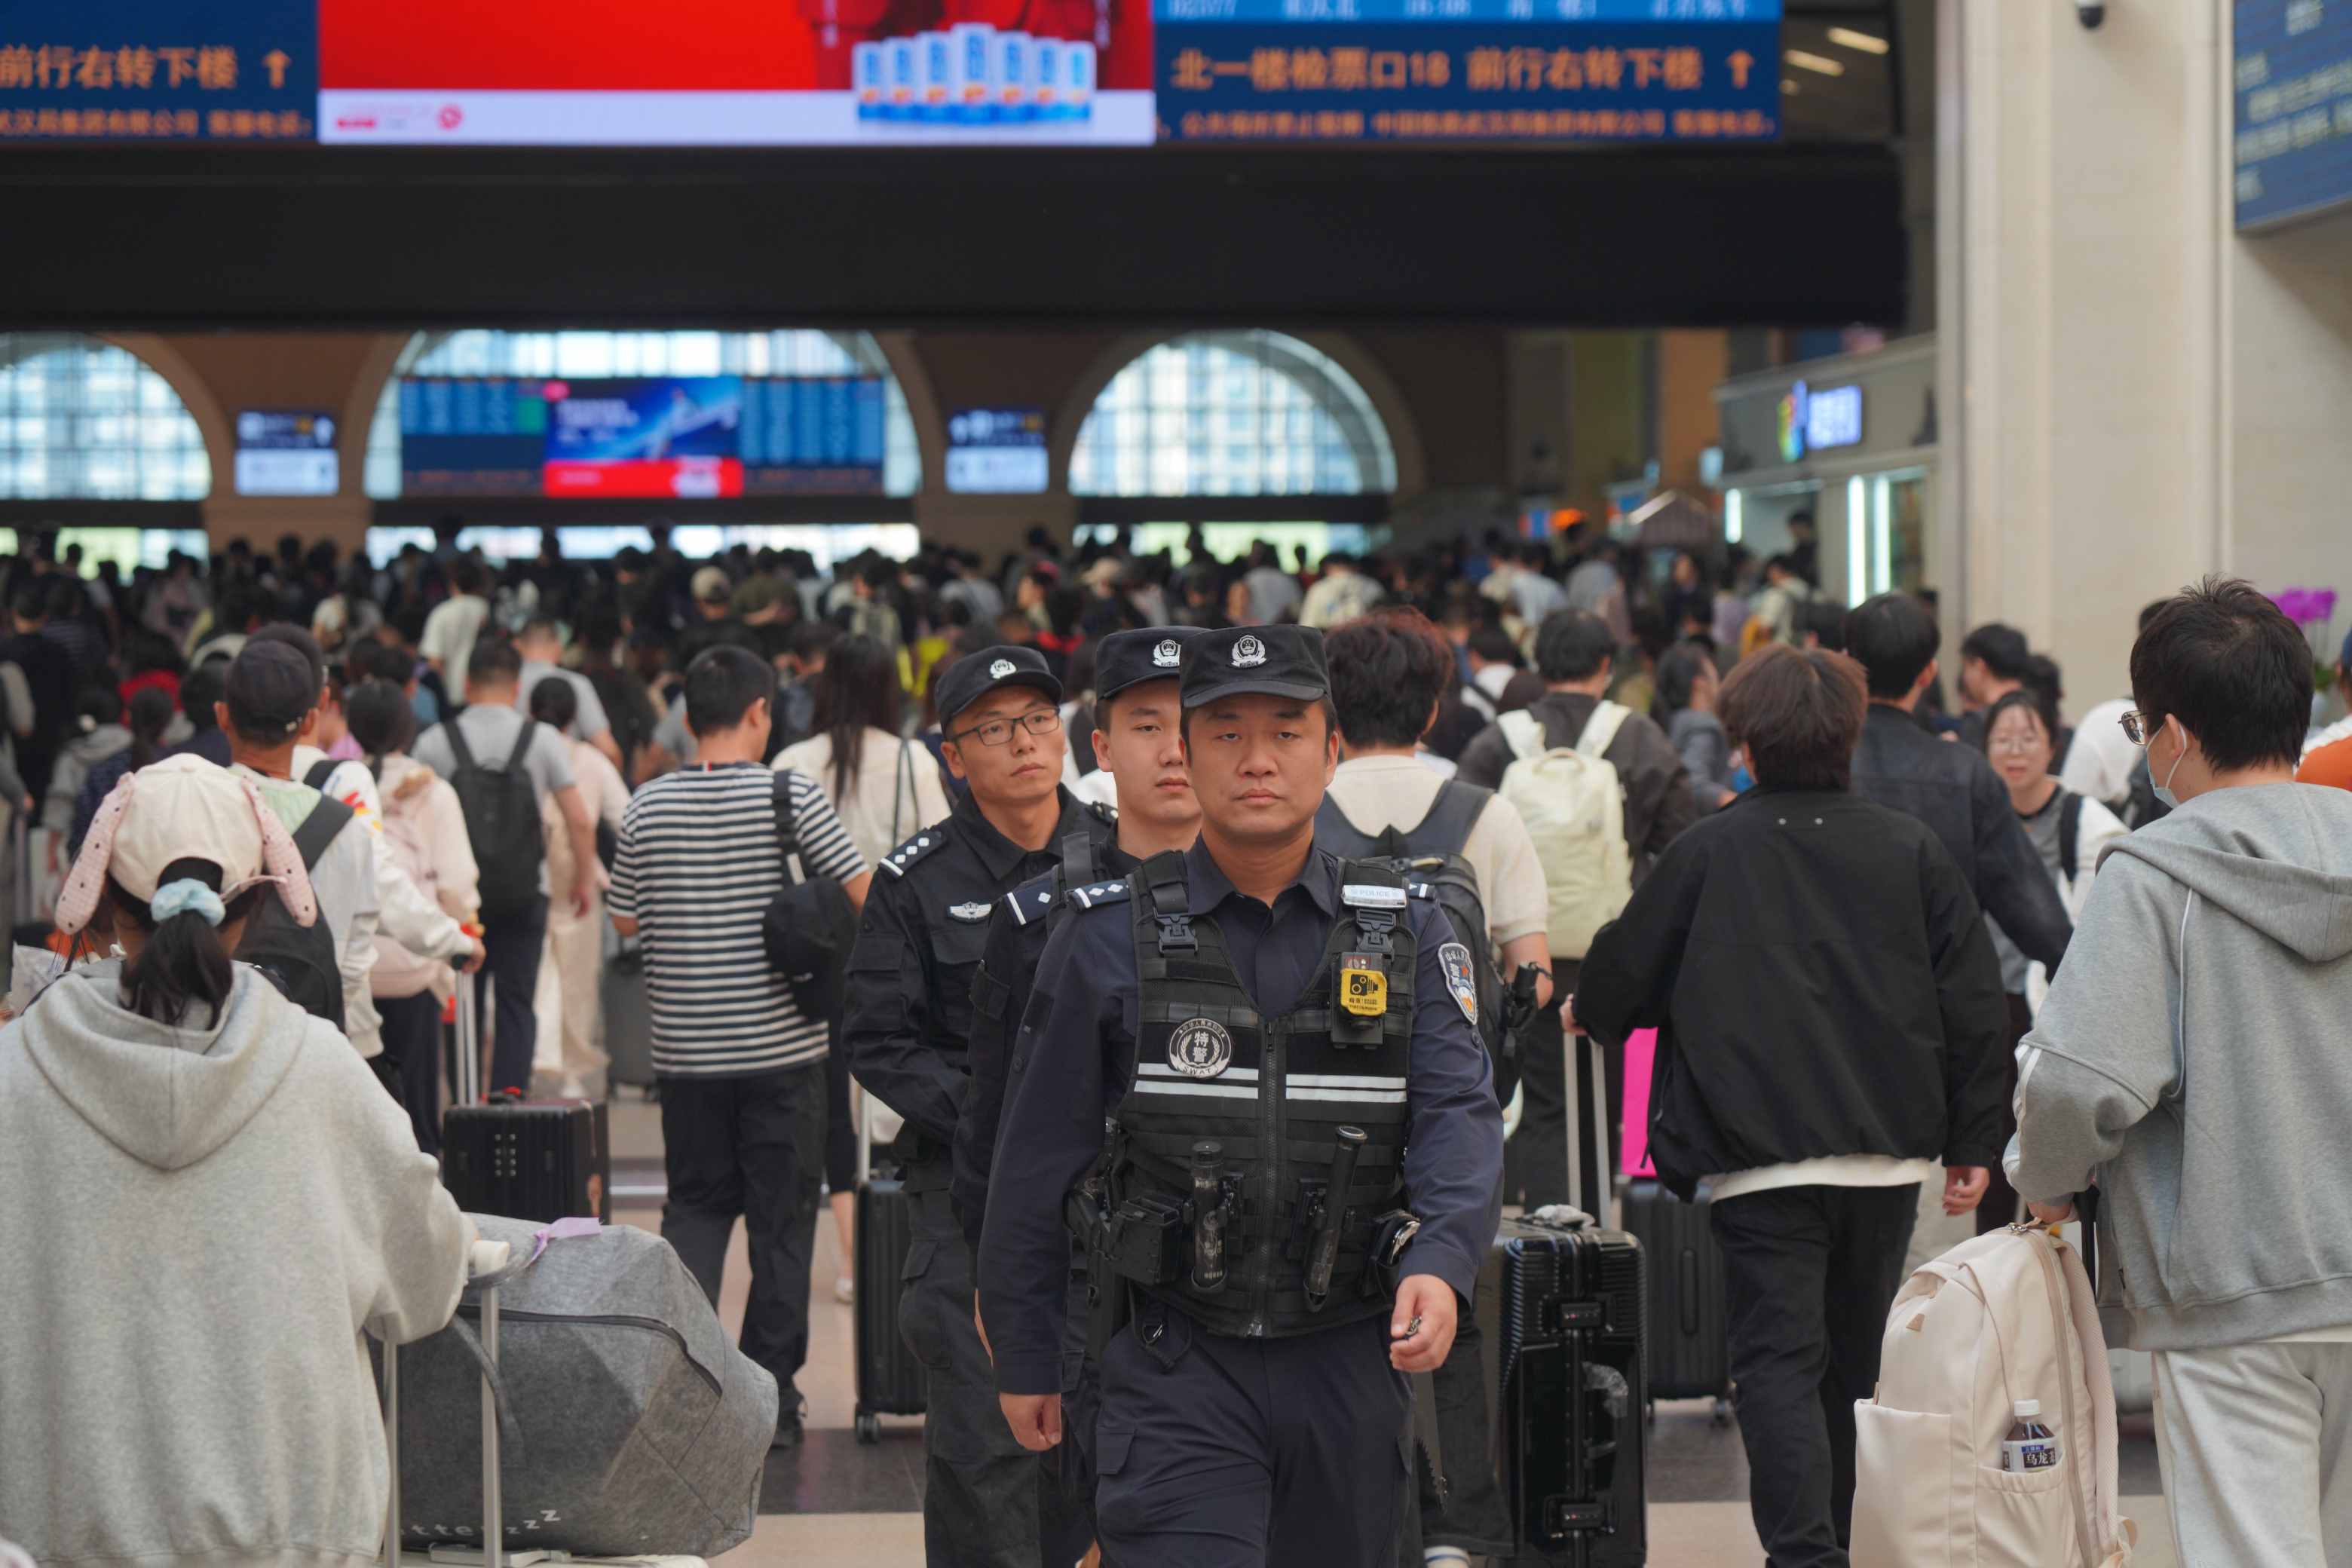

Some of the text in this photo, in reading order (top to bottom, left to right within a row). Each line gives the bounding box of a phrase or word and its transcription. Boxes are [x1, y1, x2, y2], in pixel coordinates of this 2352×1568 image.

[0, 44, 237, 89] 前行右转下楼
[1466, 46, 1701, 90] 前行右转下楼
[1193, 1031, 1209, 1063] 特警
[1182, 1064, 1214, 1075] SWAT
